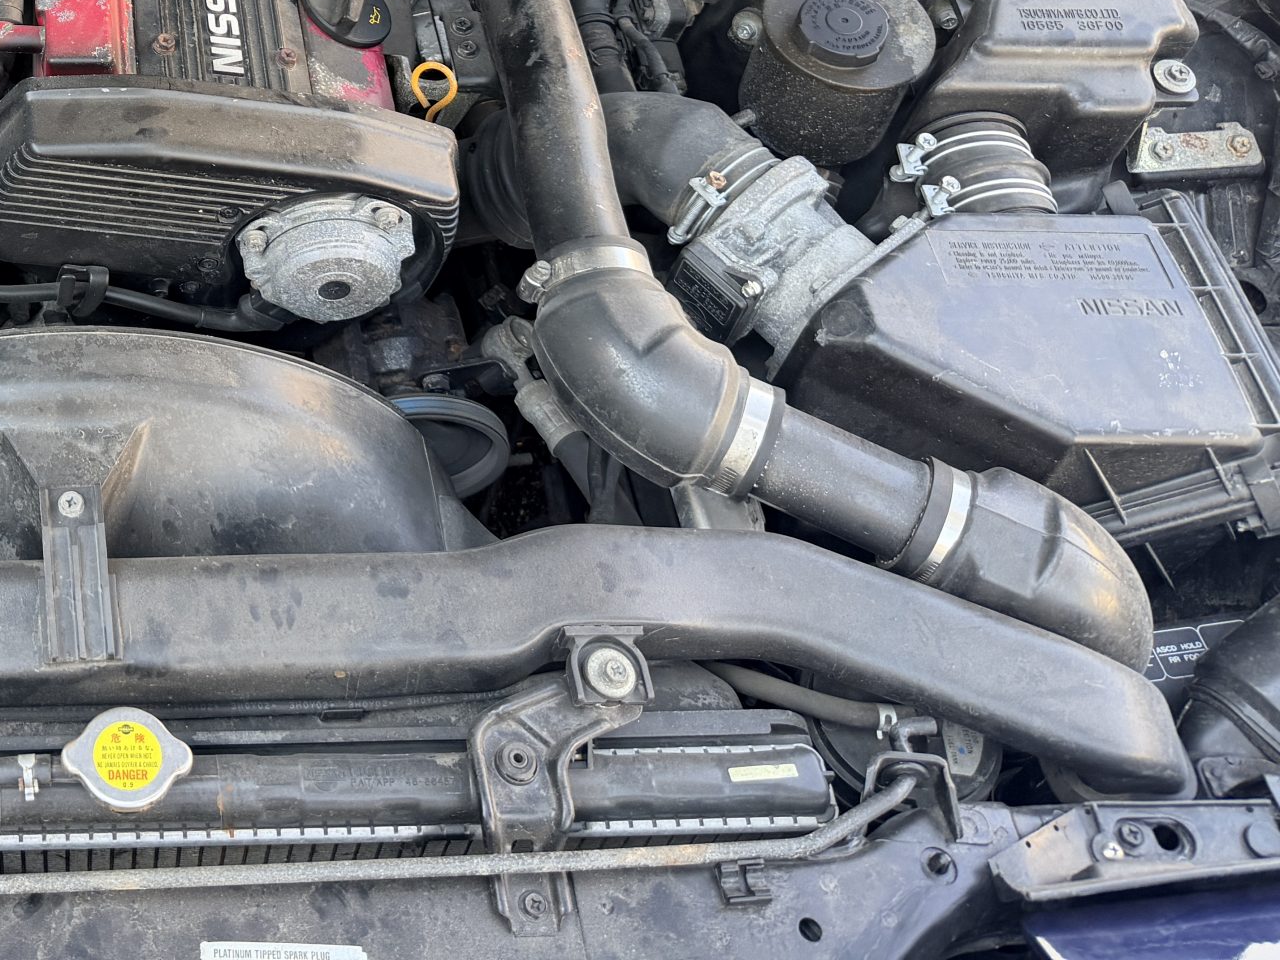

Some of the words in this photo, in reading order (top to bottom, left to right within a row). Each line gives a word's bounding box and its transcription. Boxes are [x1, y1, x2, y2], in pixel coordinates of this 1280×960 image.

[1078, 296, 1184, 316] NISSAN
[1155, 644, 1178, 654] ASCD
[1180, 641, 1203, 650] HOLD
[1168, 655, 1182, 664] RR
[108, 770, 148, 780] DANGER
[213, 948, 252, 959] PLATINUM
[255, 949, 282, 960] TIPPED
[284, 950, 309, 960] SPARK
[311, 951, 331, 960] PLUG
